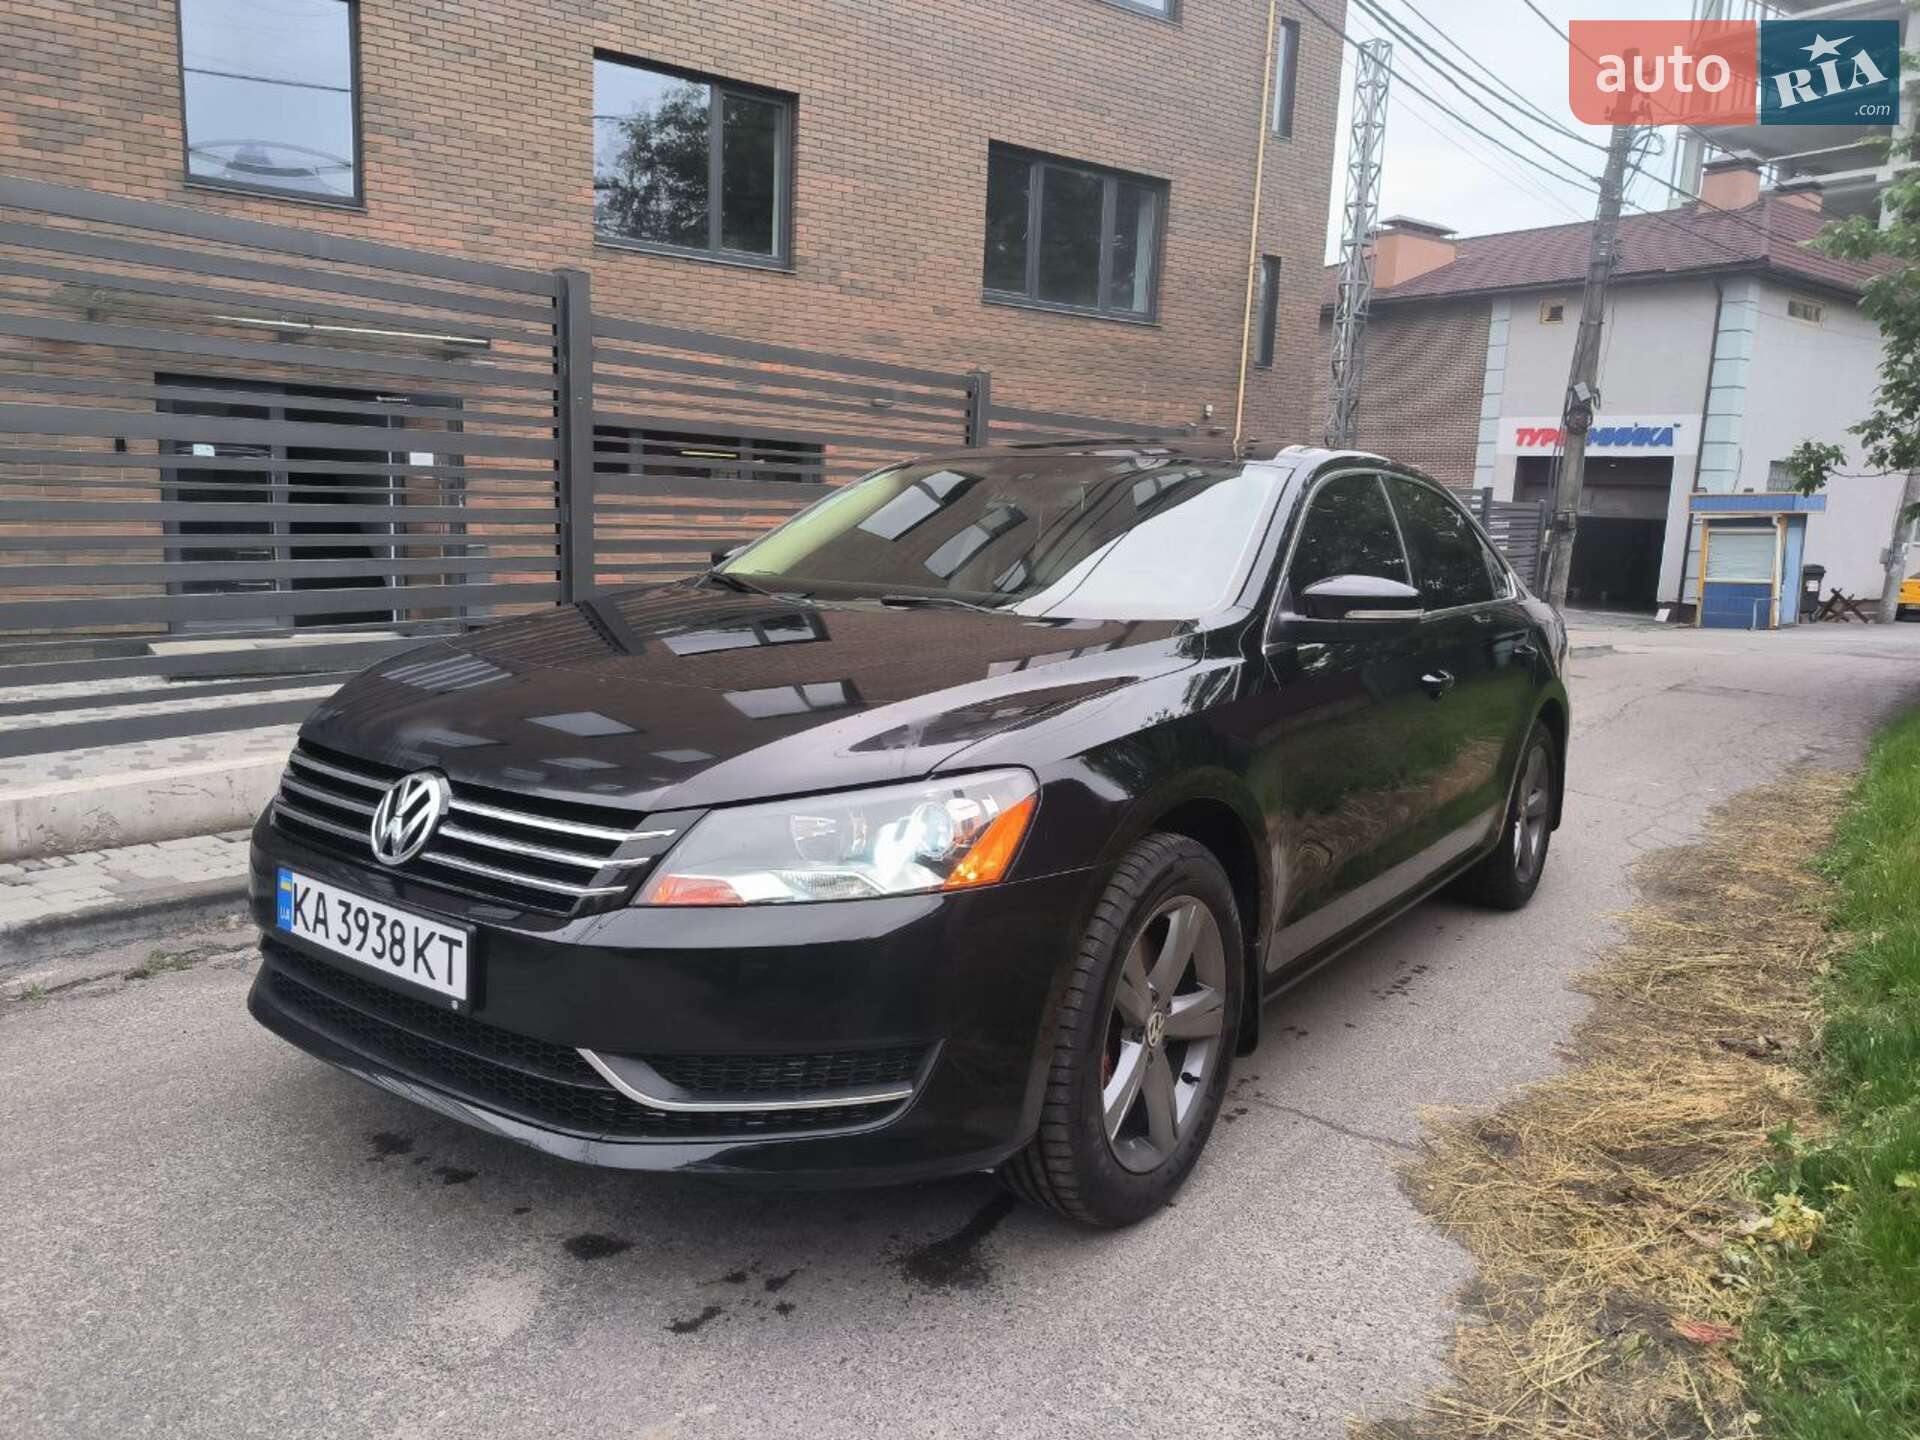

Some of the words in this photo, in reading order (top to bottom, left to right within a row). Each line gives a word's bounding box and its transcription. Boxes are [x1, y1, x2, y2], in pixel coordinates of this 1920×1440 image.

[293, 882, 330, 940] KA
[337, 899, 406, 967] 3938
[413, 925, 463, 986] KT
